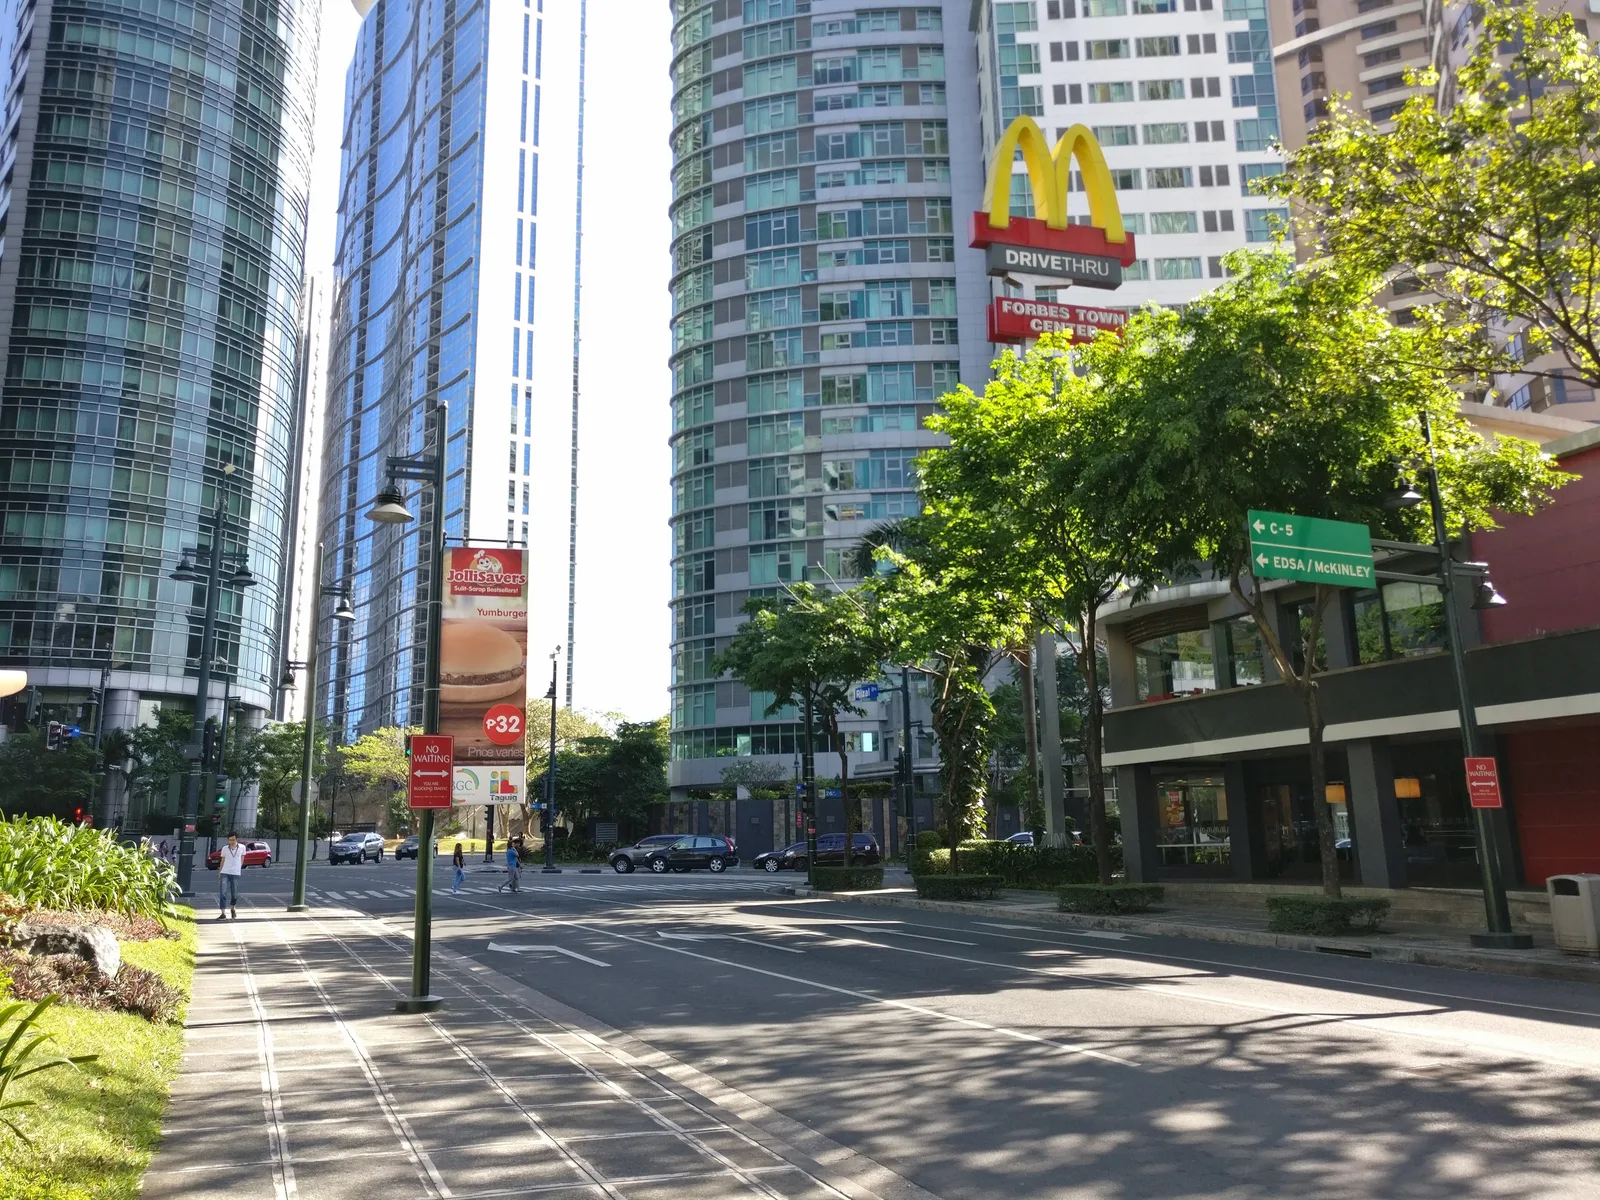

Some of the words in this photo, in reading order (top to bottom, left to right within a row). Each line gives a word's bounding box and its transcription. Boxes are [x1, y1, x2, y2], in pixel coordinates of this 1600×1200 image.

[1002, 300, 1070, 319] FORBES
[1075, 308, 1125, 326] TOWN
[1270, 522, 1293, 536] C-5
[1274, 556, 1304, 572] EDSA
[1314, 562, 1370, 578] McKINLEY
[446, 568, 526, 584] JolliSavers
[477, 608, 527, 618] Yumburger
[425, 745, 440, 754] NO
[468, 746, 494, 758] Price
[413, 754, 450, 763] WAITING
[490, 794, 518, 802] Taguig
